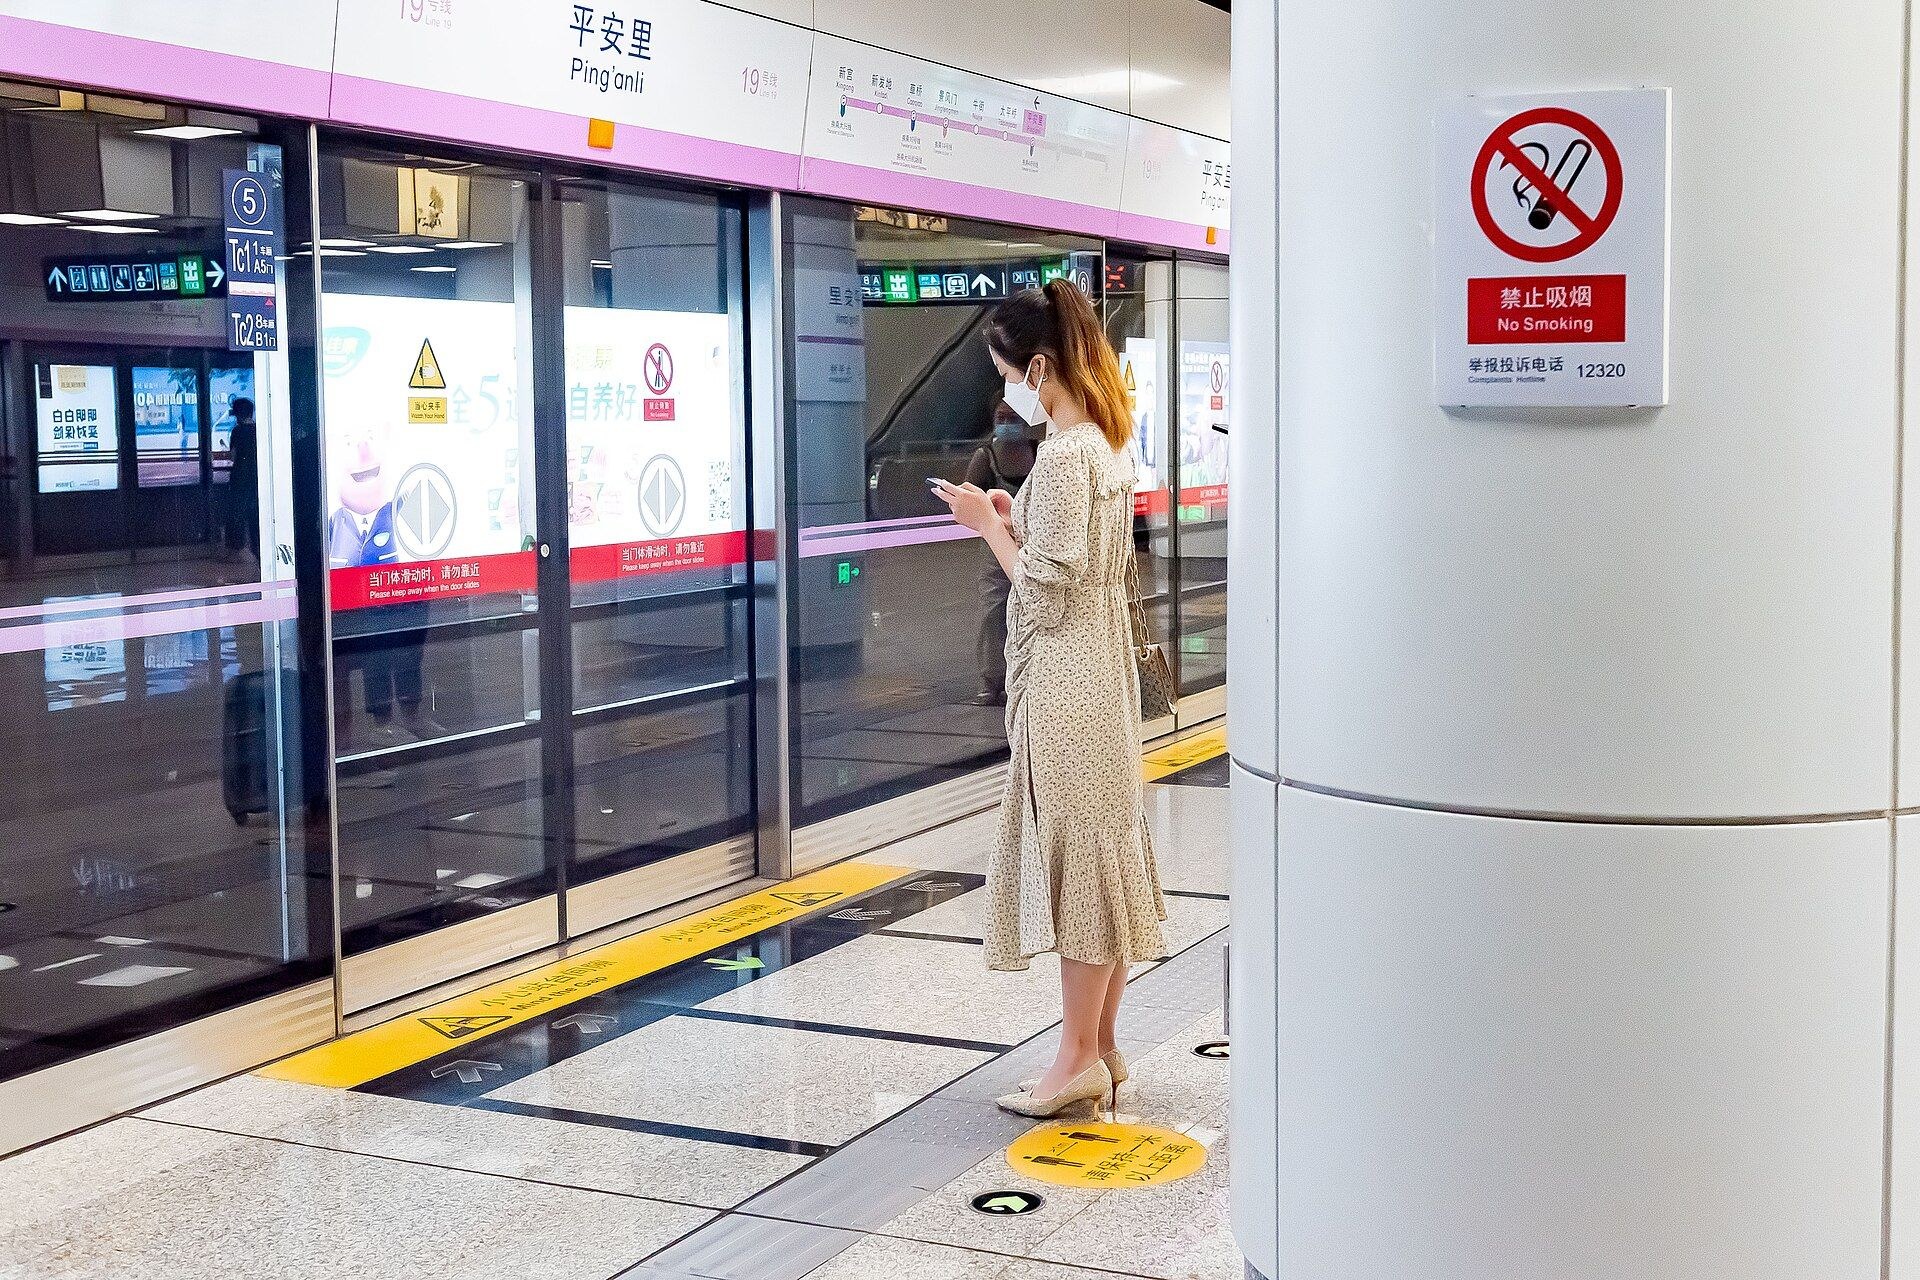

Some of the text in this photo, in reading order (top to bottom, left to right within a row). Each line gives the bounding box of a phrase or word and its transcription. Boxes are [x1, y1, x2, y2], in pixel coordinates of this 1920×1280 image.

[570, 4, 652, 61] 平安里
[571, 57, 644, 94] Ping'anli
[242, 187, 257, 215] 5
[228, 238, 251, 273] Tc1
[1500, 285, 1592, 309] 禁止吸烟
[231, 312, 254, 347] Tc2
[1497, 317, 1593, 333] No Smoking
[1469, 356, 1626, 378] 举报投诉电话 12320
[414, 401, 441, 411] 当心夹手
[622, 563, 638, 572] Please
[369, 580, 480, 600] Please keep away when the door slides
[510, 976, 609, 1011] Mind the Gap
